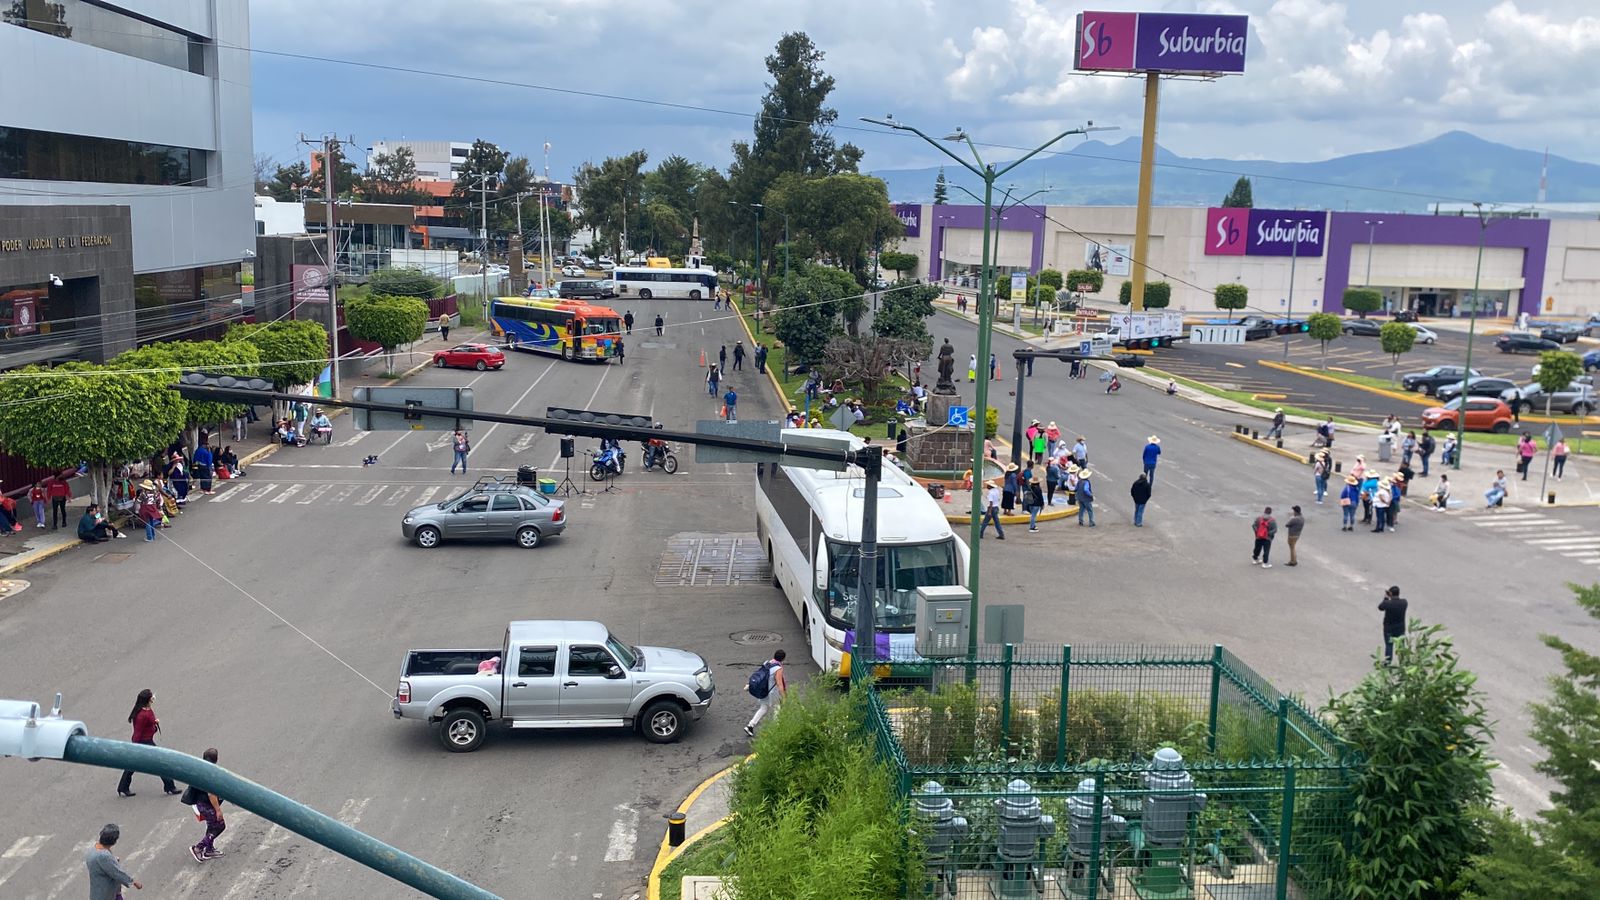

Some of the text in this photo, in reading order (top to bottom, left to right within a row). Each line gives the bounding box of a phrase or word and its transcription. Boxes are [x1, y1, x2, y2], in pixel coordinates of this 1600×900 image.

[1082, 20, 1112, 59] Sb
[1158, 26, 1244, 57] Suburbia
[1, 239, 23, 251] PODER
[27, 238, 54, 250] JUDICIAL
[57, 237, 66, 248] DE
[1215, 216, 1240, 248] Sb
[1257, 219, 1320, 245] Suburbia
